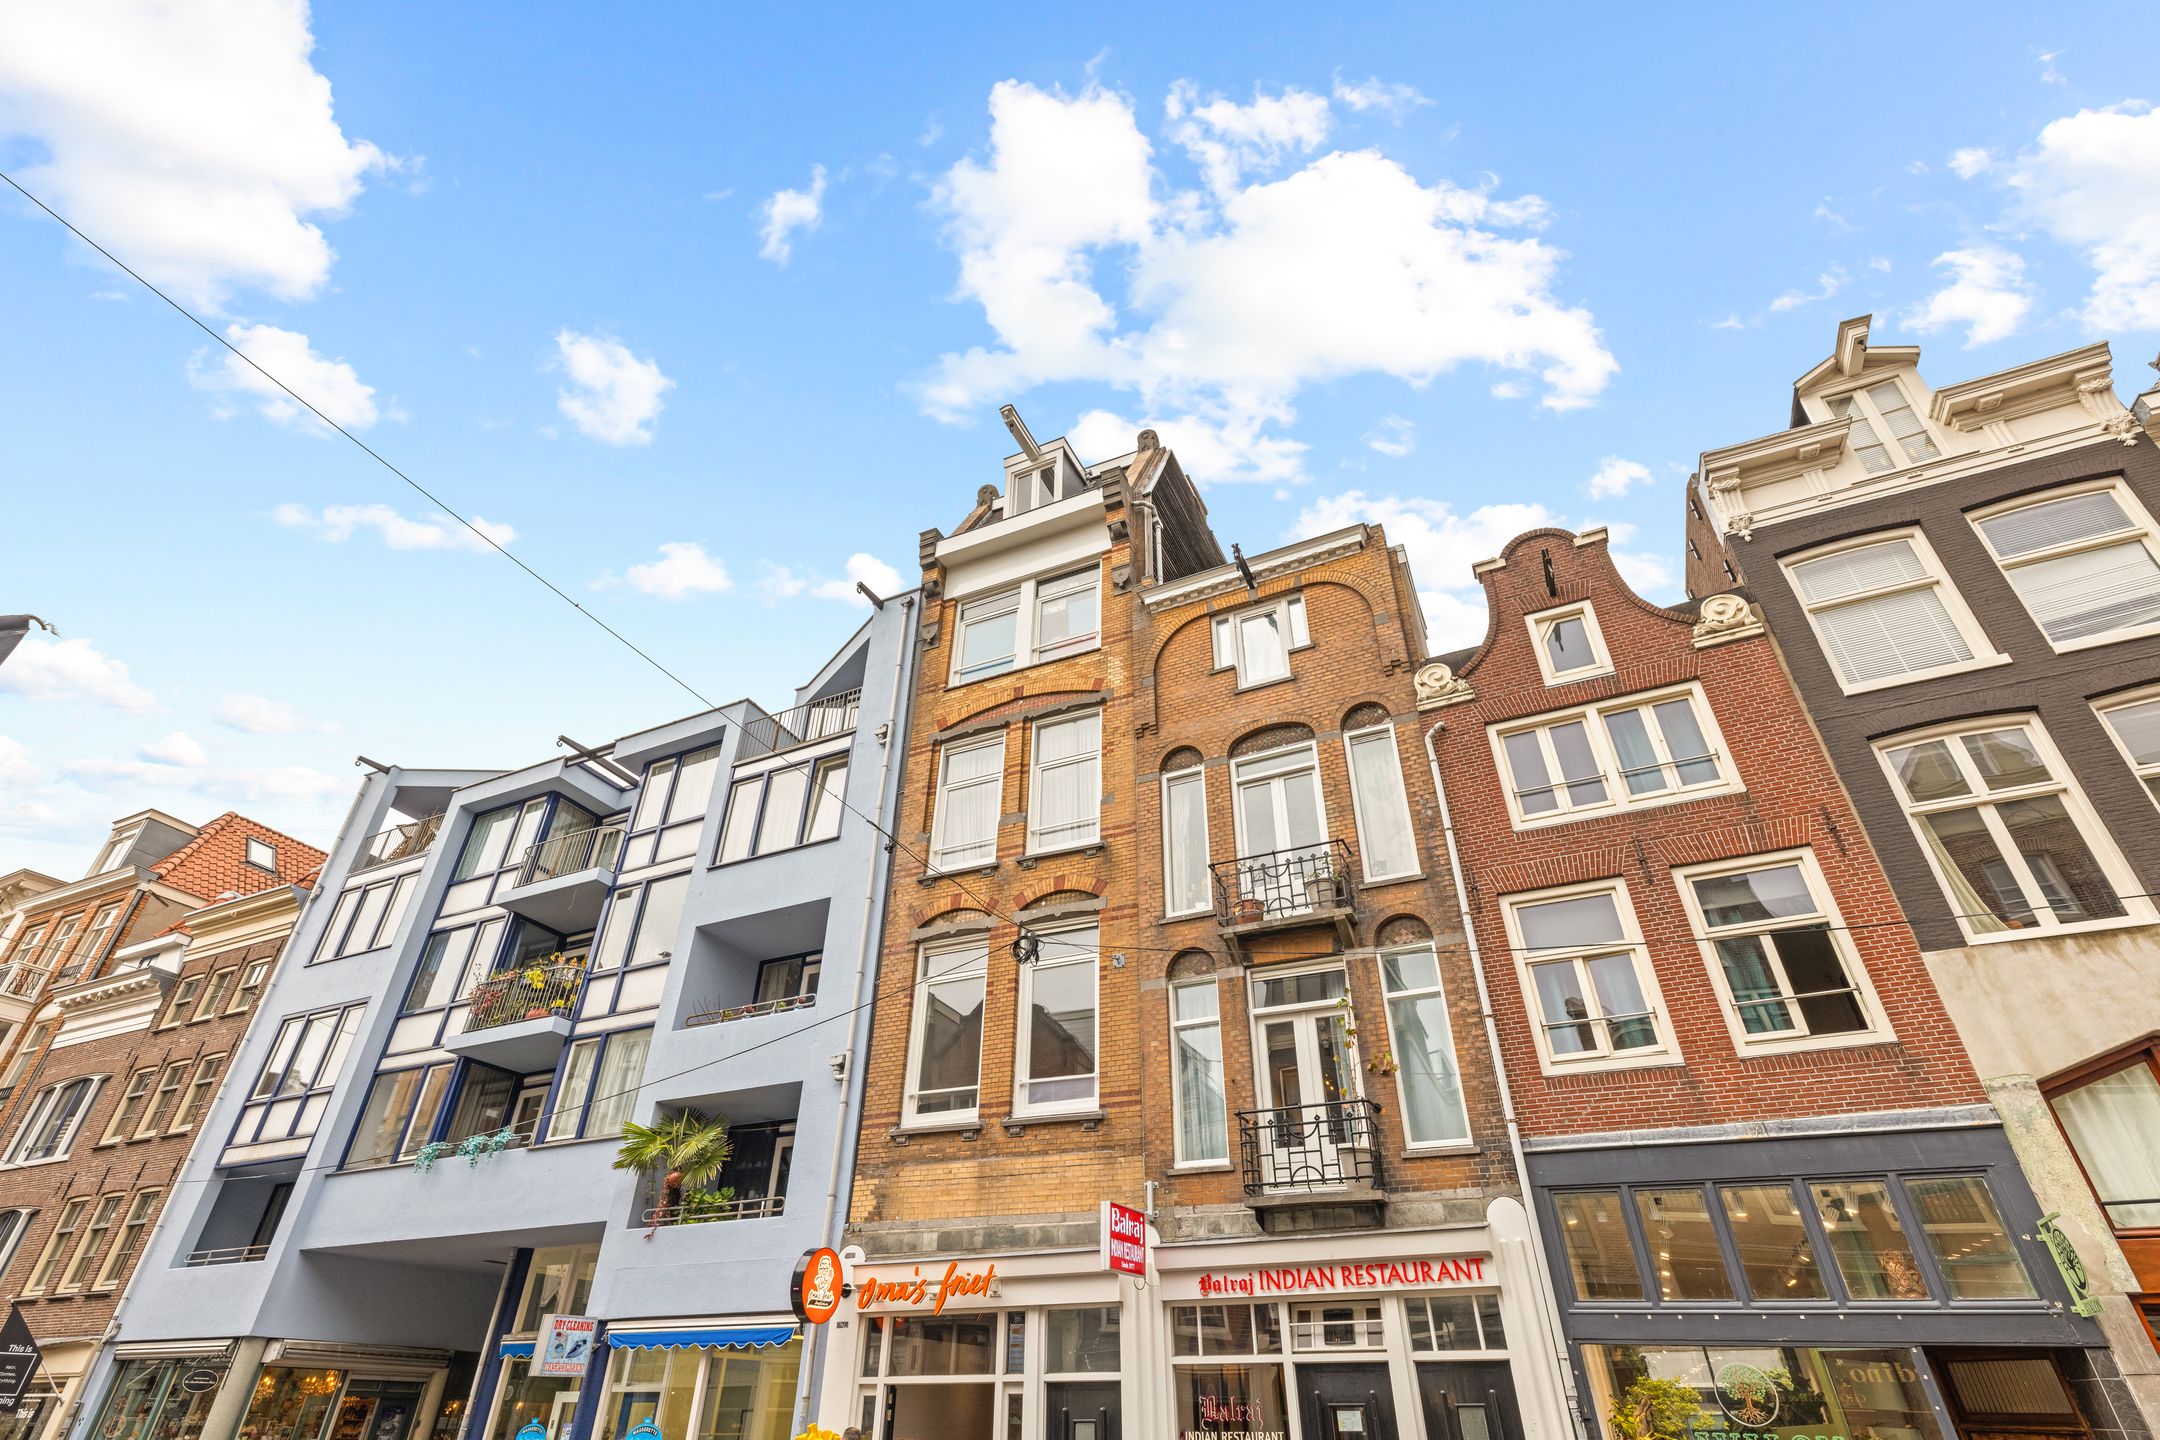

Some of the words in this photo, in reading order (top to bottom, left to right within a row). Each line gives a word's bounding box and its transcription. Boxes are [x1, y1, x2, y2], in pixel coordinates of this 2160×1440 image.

[1111, 1207, 1144, 1244] Balraj
[1124, 1242, 1144, 1262] RESTAURANT
[1198, 1272, 1255, 1296] Balraj
[1258, 1266, 1335, 1291] INDIAN
[1341, 1258, 1485, 1287] RESTAURANT
[858, 1265, 928, 1309] Oma's
[932, 1261, 998, 1316] friet
[554, 1320, 566, 1329] DRY
[566, 1320, 594, 1332] CLEANING
[8, 1344, 24, 1353] This
[24, 1344, 33, 1353] is
[15, 1408, 28, 1418] This
[26, 1408, 35, 1418] is
[1199, 1395, 1264, 1431] Balraj
[1184, 1431, 1218, 1440] INDIAN
[1220, 1431, 1284, 1440] RESTAURANT
